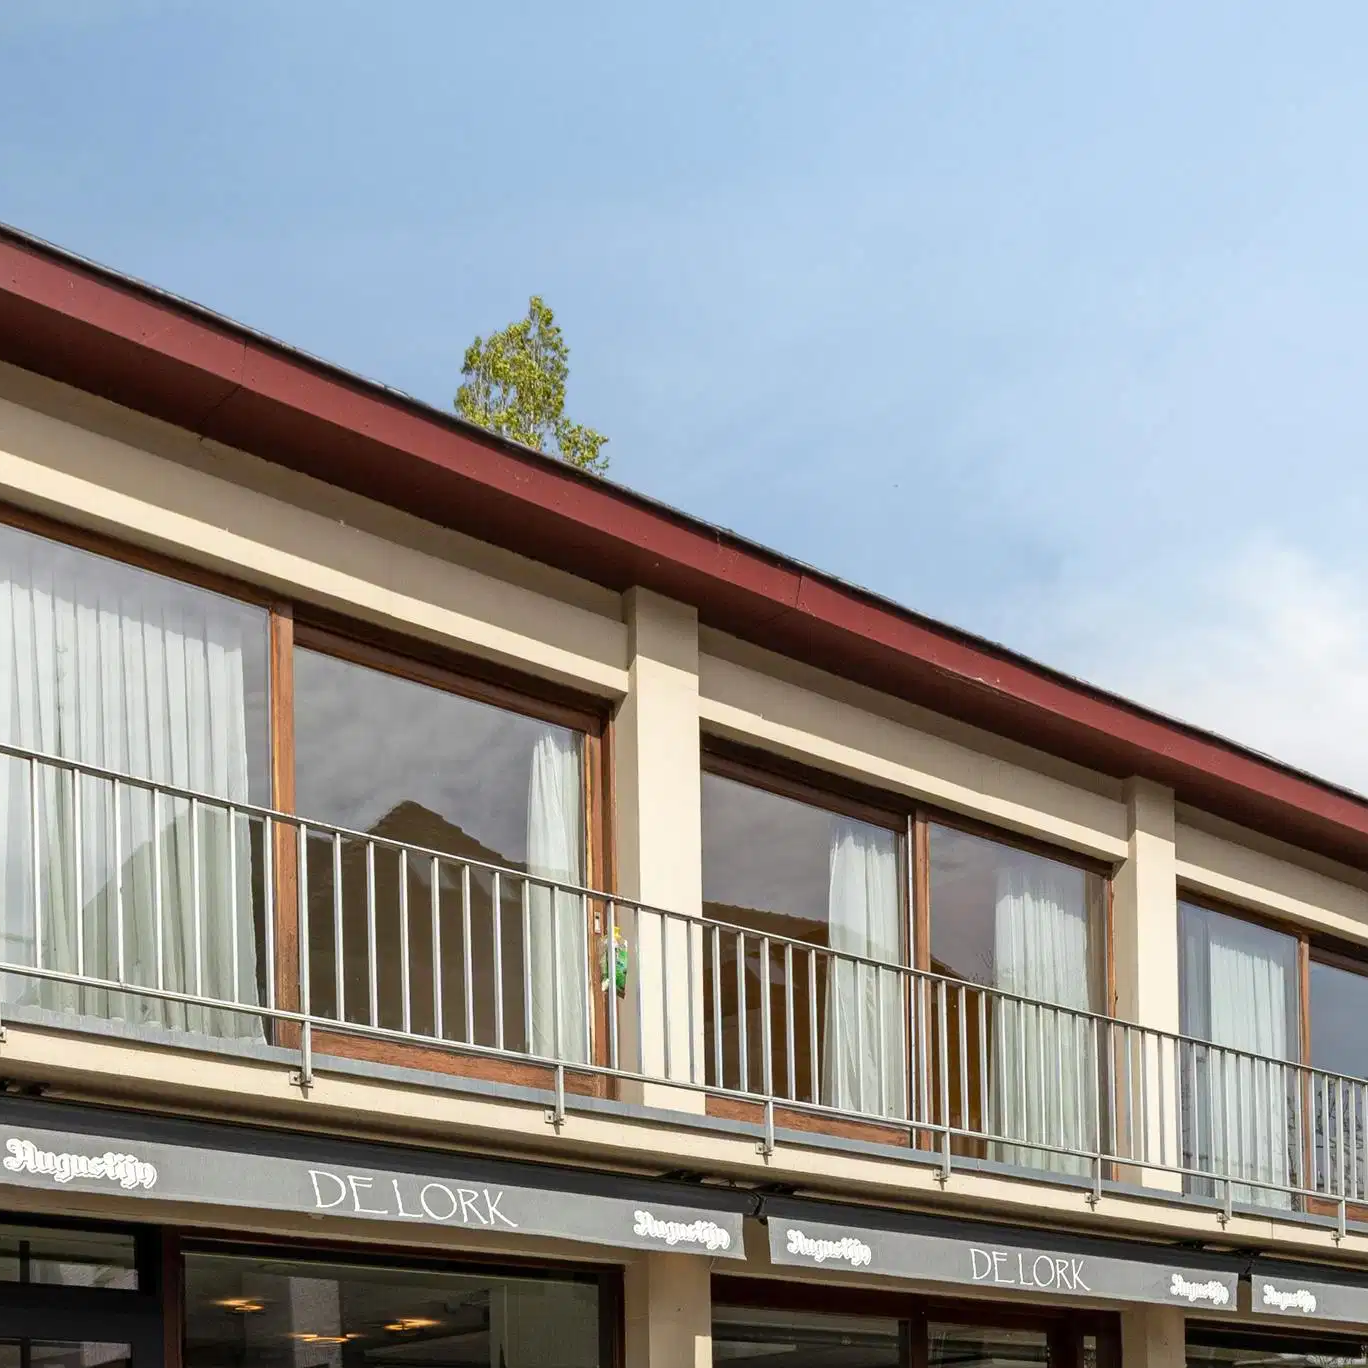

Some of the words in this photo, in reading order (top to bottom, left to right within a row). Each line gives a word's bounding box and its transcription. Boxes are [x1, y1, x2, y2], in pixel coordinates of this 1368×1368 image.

[3, 1137, 158, 1190] Augustijn
[307, 1169, 389, 1214] DE
[392, 1178, 519, 1228] LORK
[633, 1209, 731, 1251] Augustijn
[786, 1228, 873, 1267] Augustijn
[969, 1247, 1016, 1284] DE
[1017, 1252, 1092, 1292] LORK
